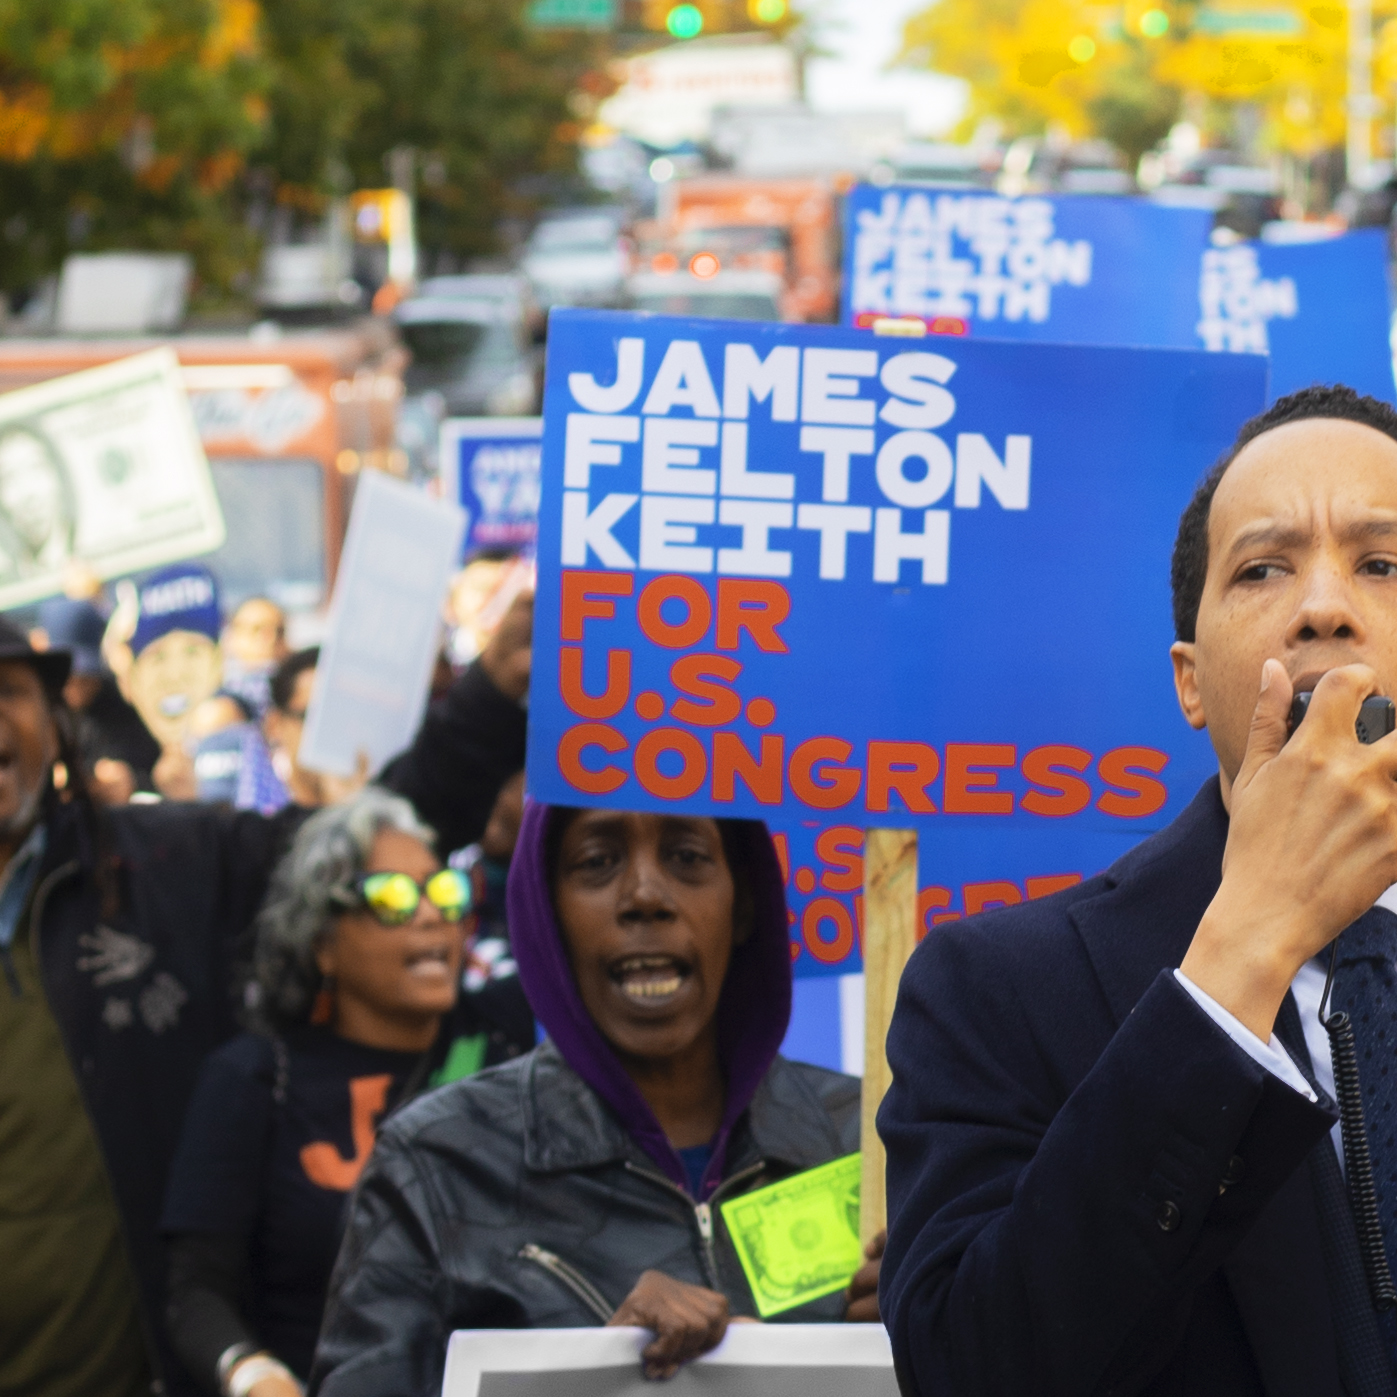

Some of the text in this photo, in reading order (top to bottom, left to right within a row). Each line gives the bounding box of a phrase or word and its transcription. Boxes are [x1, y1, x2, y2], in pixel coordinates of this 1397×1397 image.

[855, 232, 1093, 285] FELTON
[857, 194, 1054, 238] JAMES
[853, 273, 1050, 322] KEITH
[567, 337, 958, 430] JAMES
[563, 413, 1032, 511] FELTON
[560, 490, 951, 585] KEITH
[559, 569, 792, 654] FOR
[558, 646, 776, 728] U.S.
[556, 721, 1170, 819] CONGRESS
